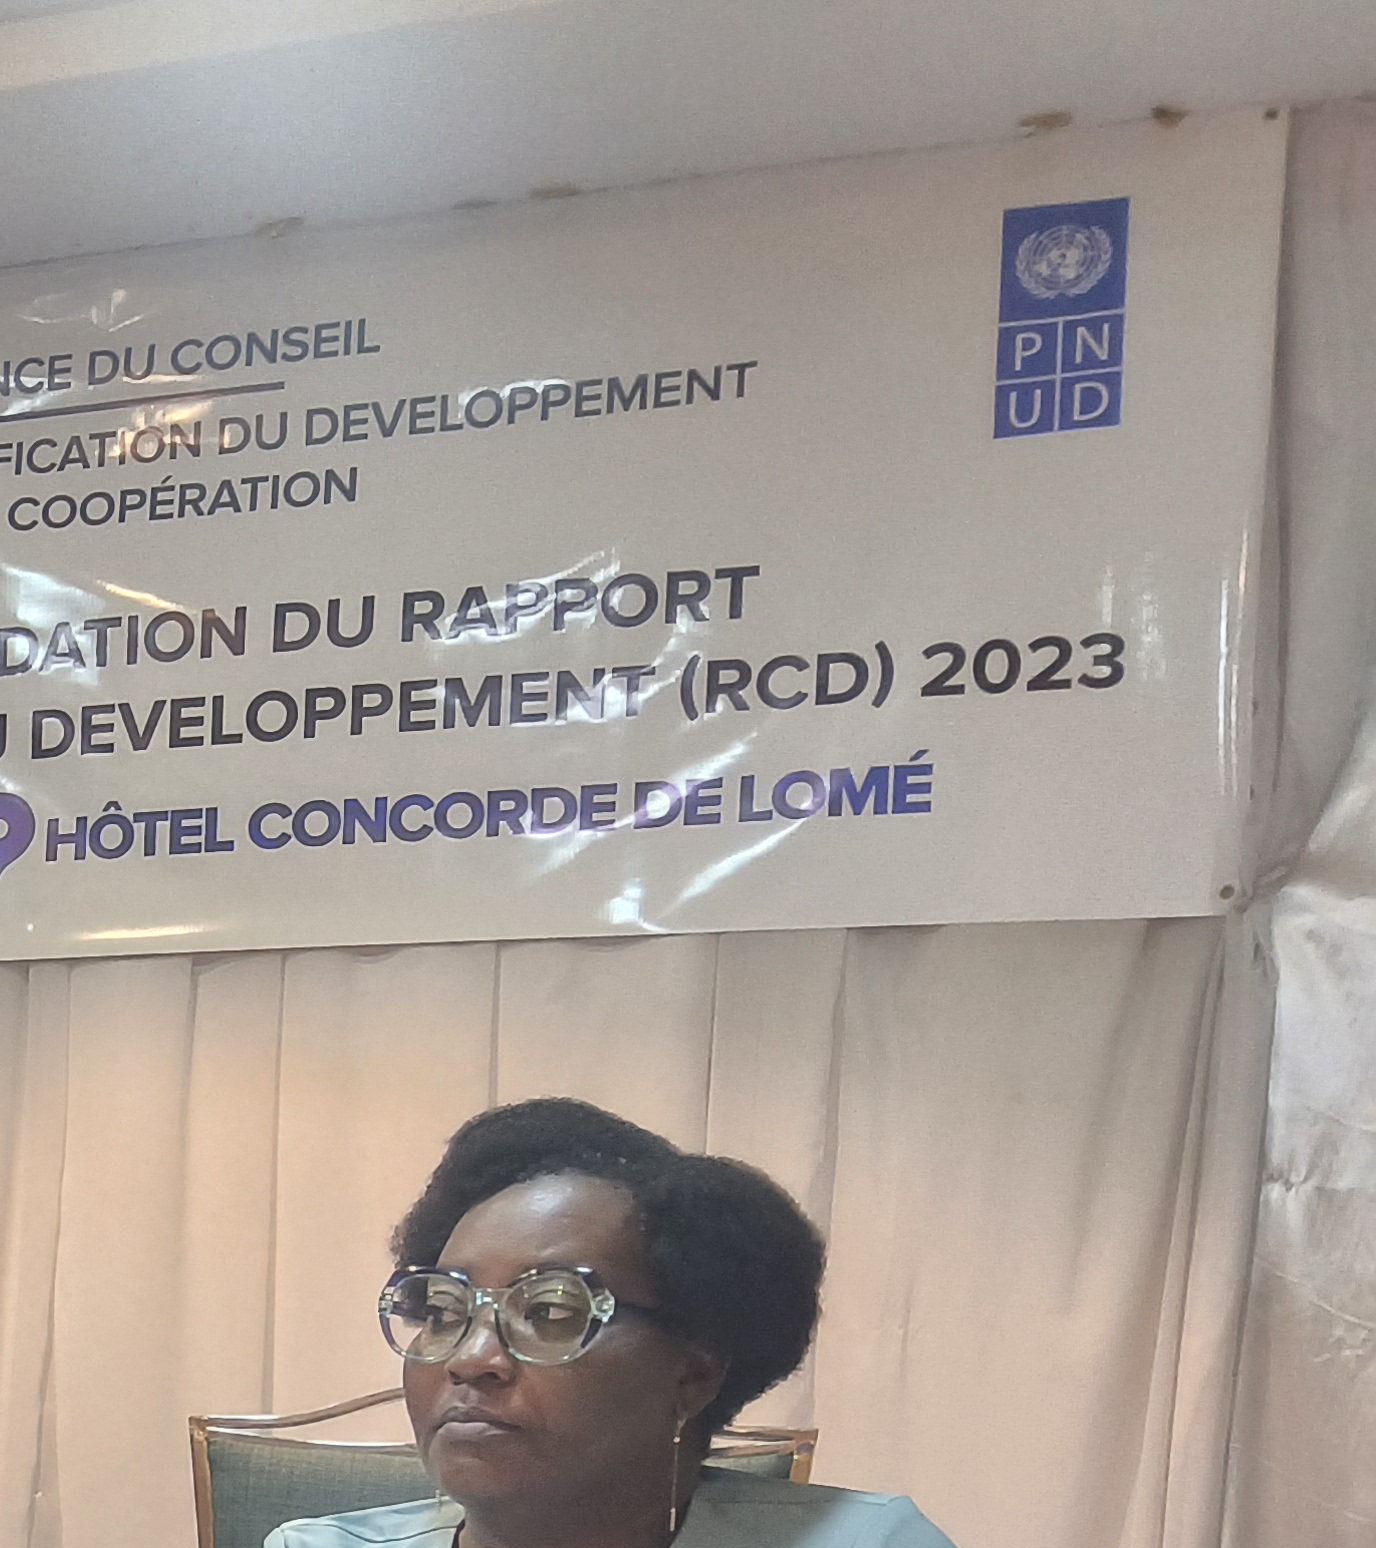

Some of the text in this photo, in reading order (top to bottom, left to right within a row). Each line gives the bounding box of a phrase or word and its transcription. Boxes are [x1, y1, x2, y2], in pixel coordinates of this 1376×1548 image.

[87, 344, 156, 385] DU
[170, 318, 381, 375] CONSEIL
[218, 412, 288, 455] DU
[303, 360, 758, 446] DEVELOPPEMENT
[7, 466, 358, 532] COOPÉRATION
[272, 595, 375, 653] DU
[400, 566, 760, 643] RAPPORT
[30, 665, 656, 760] DEVELOPPEMENT
[679, 642, 894, 721] (RCD)
[920, 633, 1125, 697] 2023
[45, 750, 934, 863] HÔTEL CONCORDE DE LOMÉ
